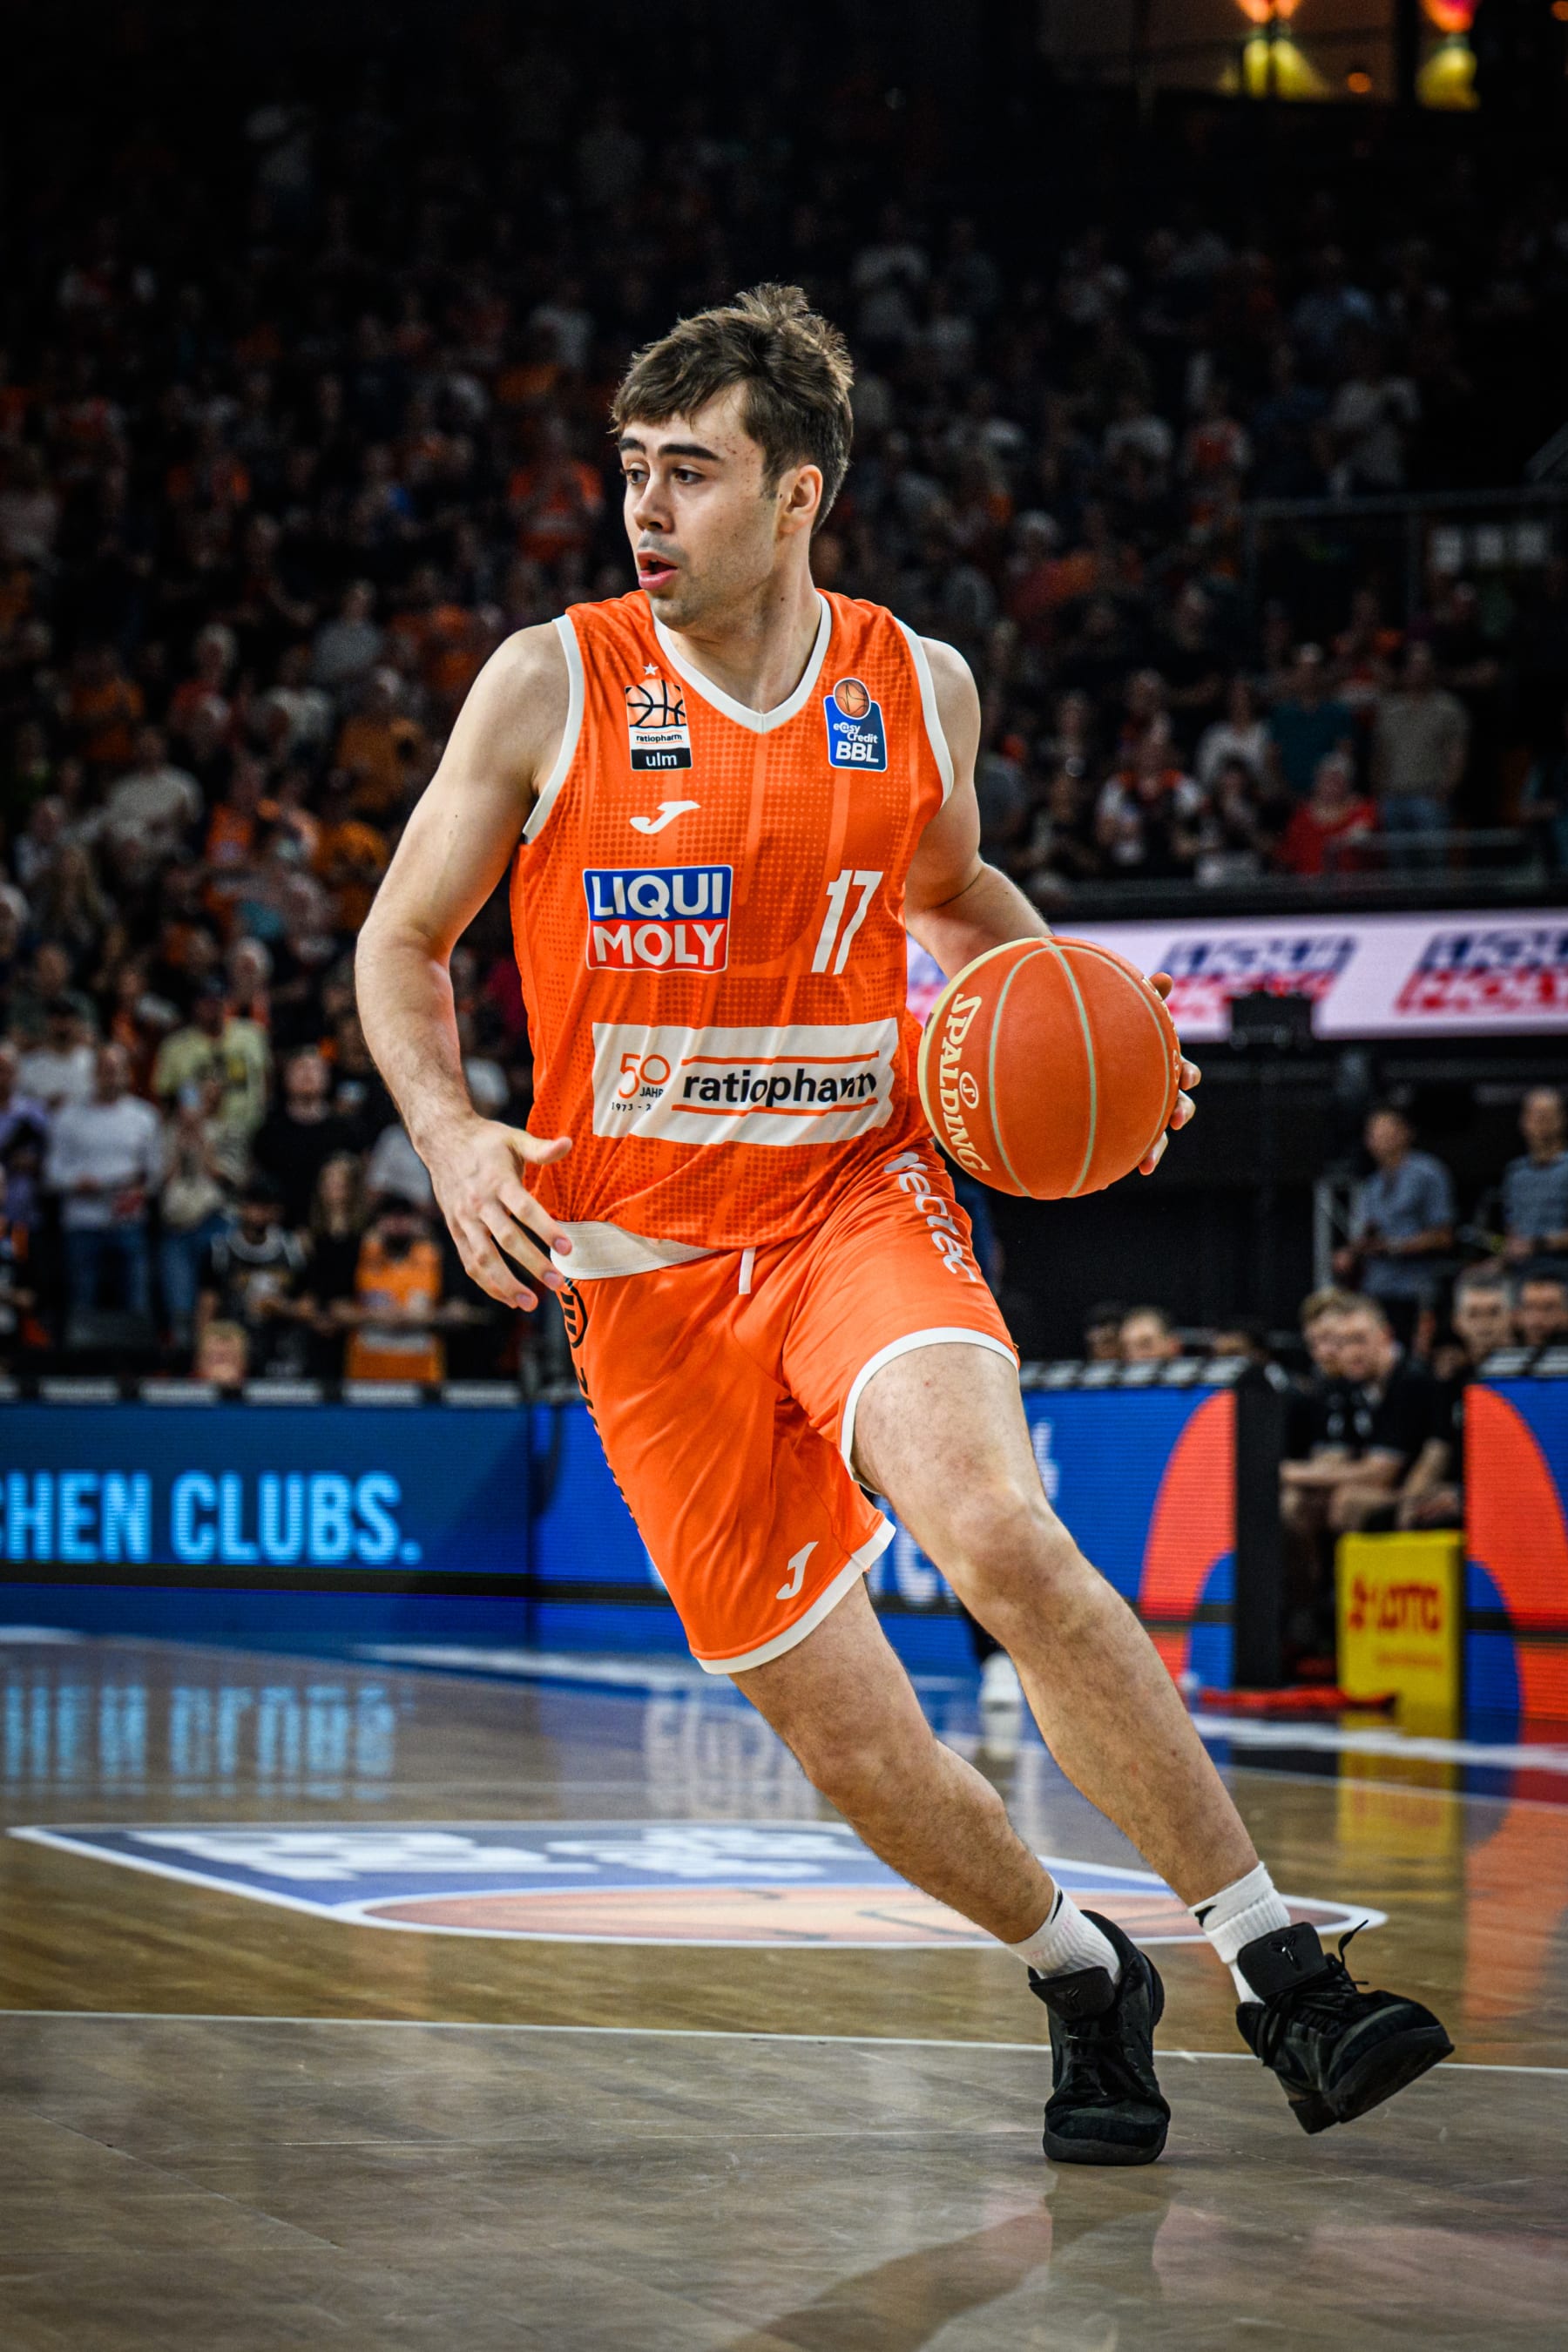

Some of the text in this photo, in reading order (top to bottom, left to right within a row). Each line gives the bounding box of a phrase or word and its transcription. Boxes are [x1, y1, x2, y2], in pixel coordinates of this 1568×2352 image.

[637, 733, 682, 743] ratiopharm
[835, 740, 879, 763] BBL
[847, 731, 878, 744] Credit
[645, 752, 677, 767] ulm
[591, 872, 724, 919] LIQUI
[811, 869, 883, 975] 17
[592, 923, 725, 966] MOLY
[618, 1052, 671, 1099] 50
[939, 993, 991, 1172] SPALDING
[612, 1102, 633, 1112] 1973
[0, 1469, 423, 1565] HEN CLUBS.
